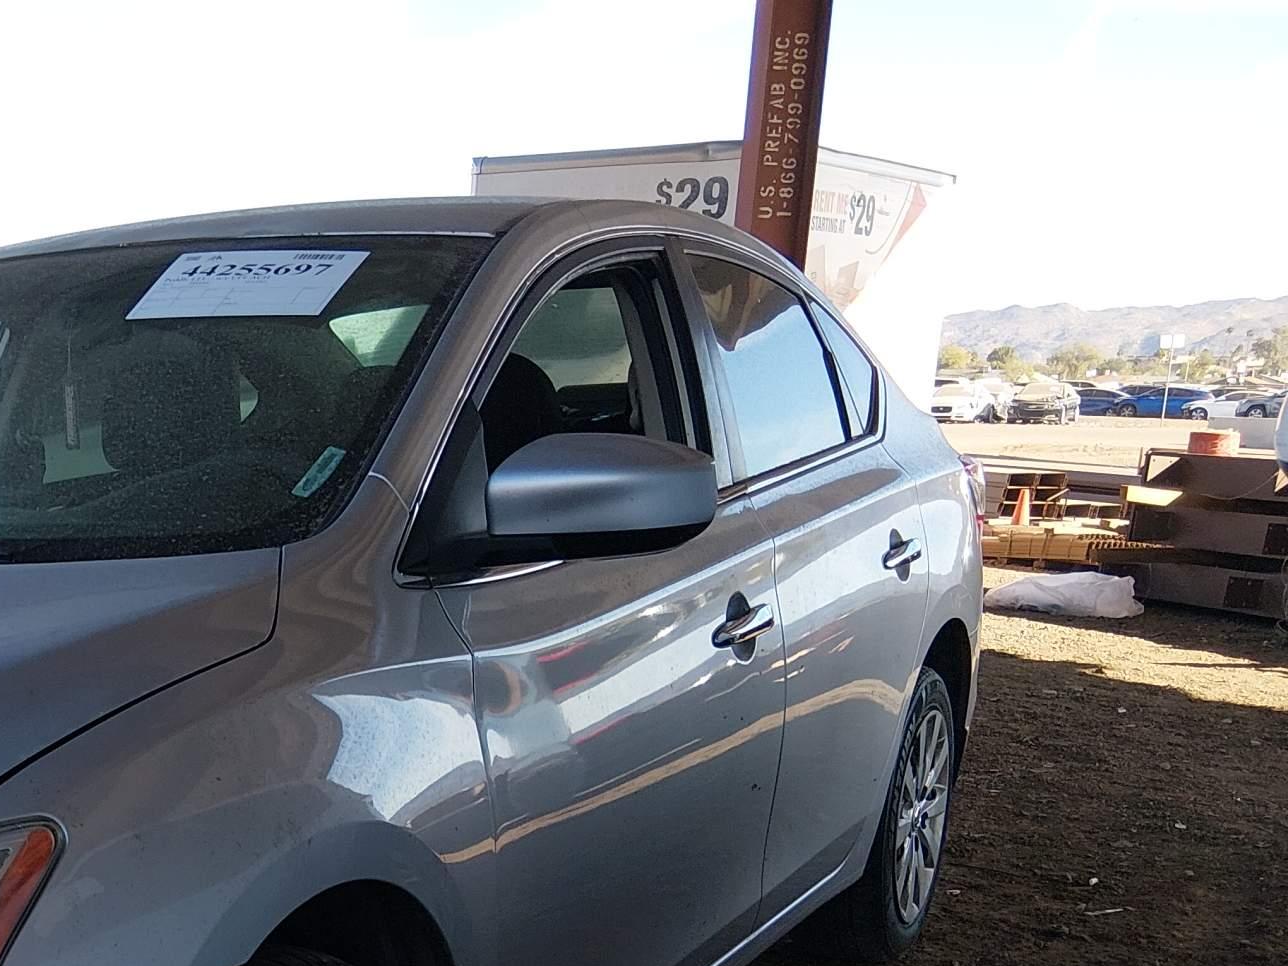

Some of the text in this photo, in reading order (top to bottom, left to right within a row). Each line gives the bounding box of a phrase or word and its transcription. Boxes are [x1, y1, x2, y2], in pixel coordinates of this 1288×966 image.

[758, 30, 791, 219] U.S. PREFAB INC.
[777, 32, 810, 218] 1-866-799-0969
[655, 176, 730, 219] $29
[813, 190, 835, 213] RENT
[849, 193, 876, 237] $29
[811, 215, 846, 234] STARTING AT
[181, 263, 336, 278] 44255697
